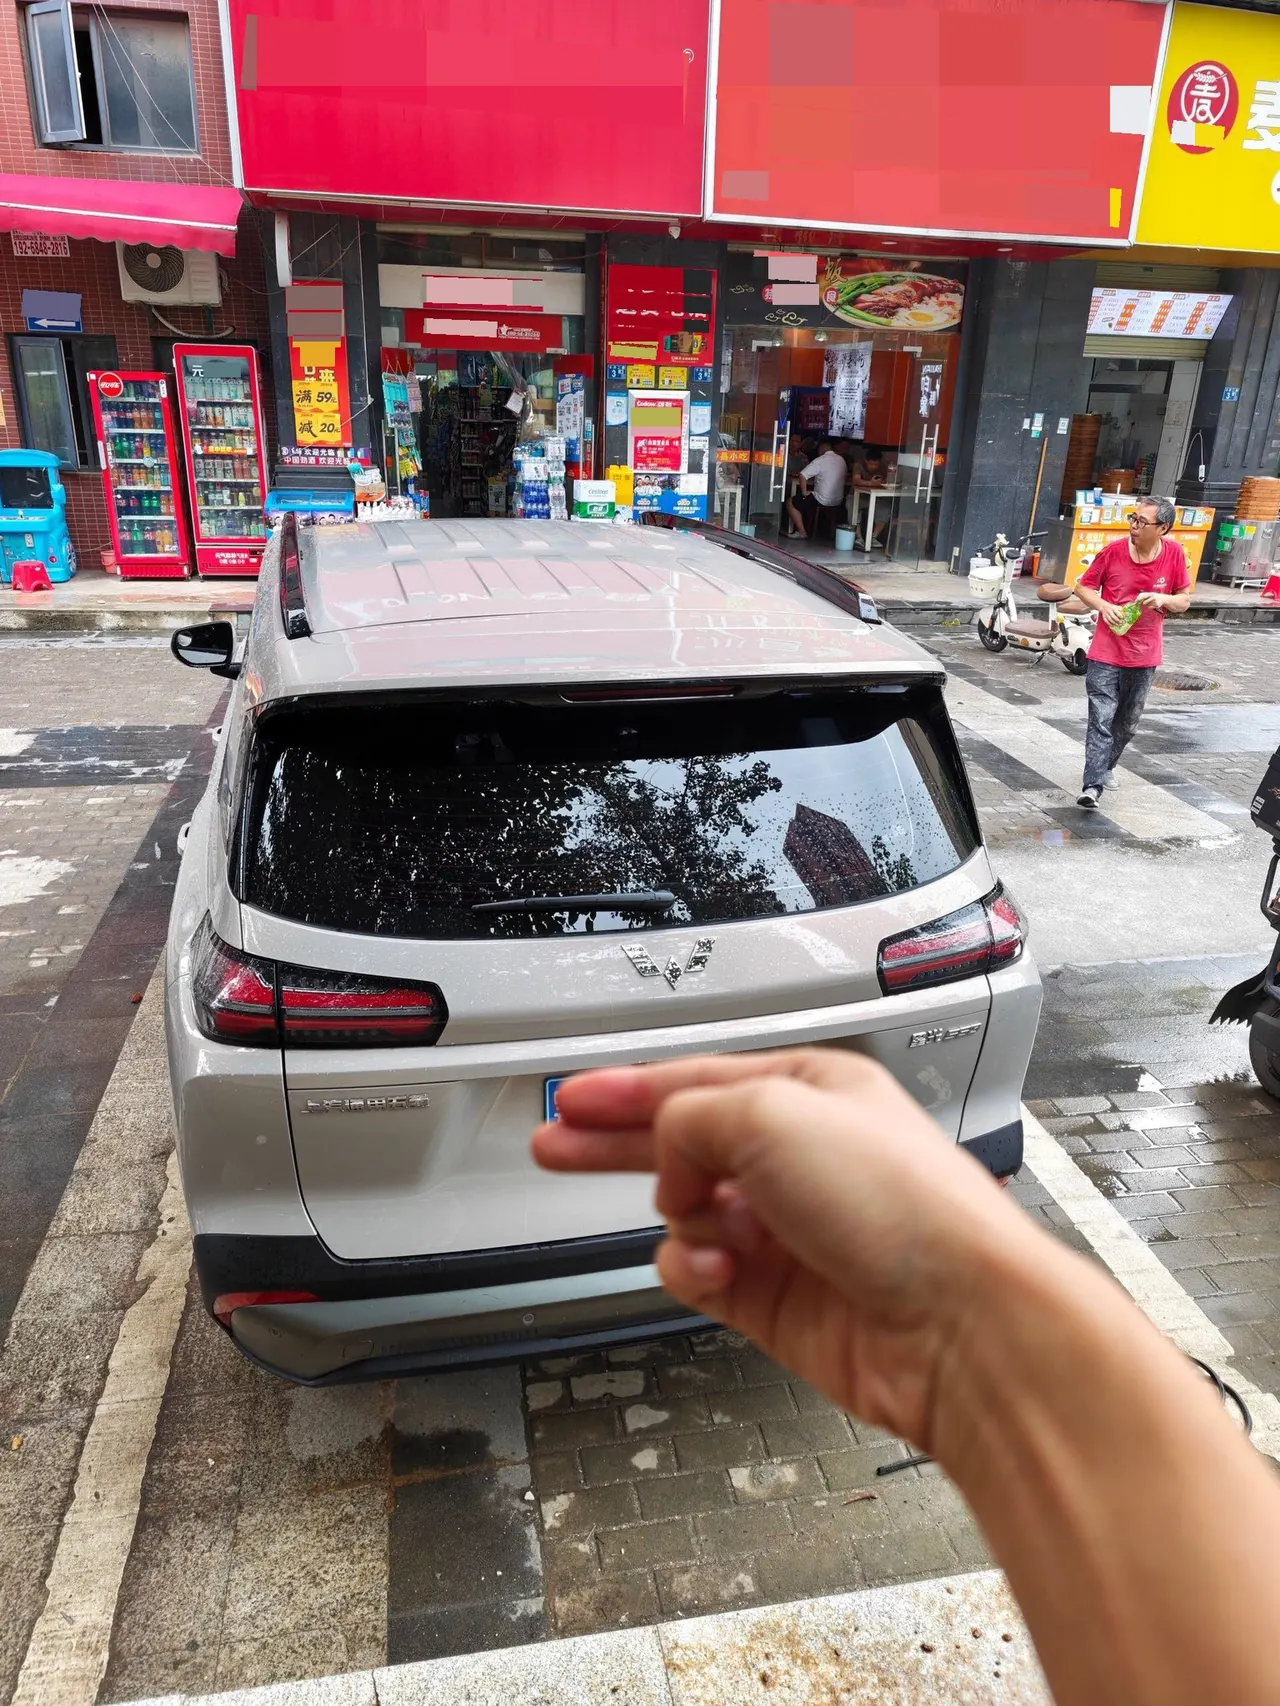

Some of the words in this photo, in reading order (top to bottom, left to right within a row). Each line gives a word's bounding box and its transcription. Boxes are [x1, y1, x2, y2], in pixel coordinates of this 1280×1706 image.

[14, 241, 69, 256] 192-6848-2816
[296, 389, 312, 404] 满
[298, 420, 318, 438] 减
